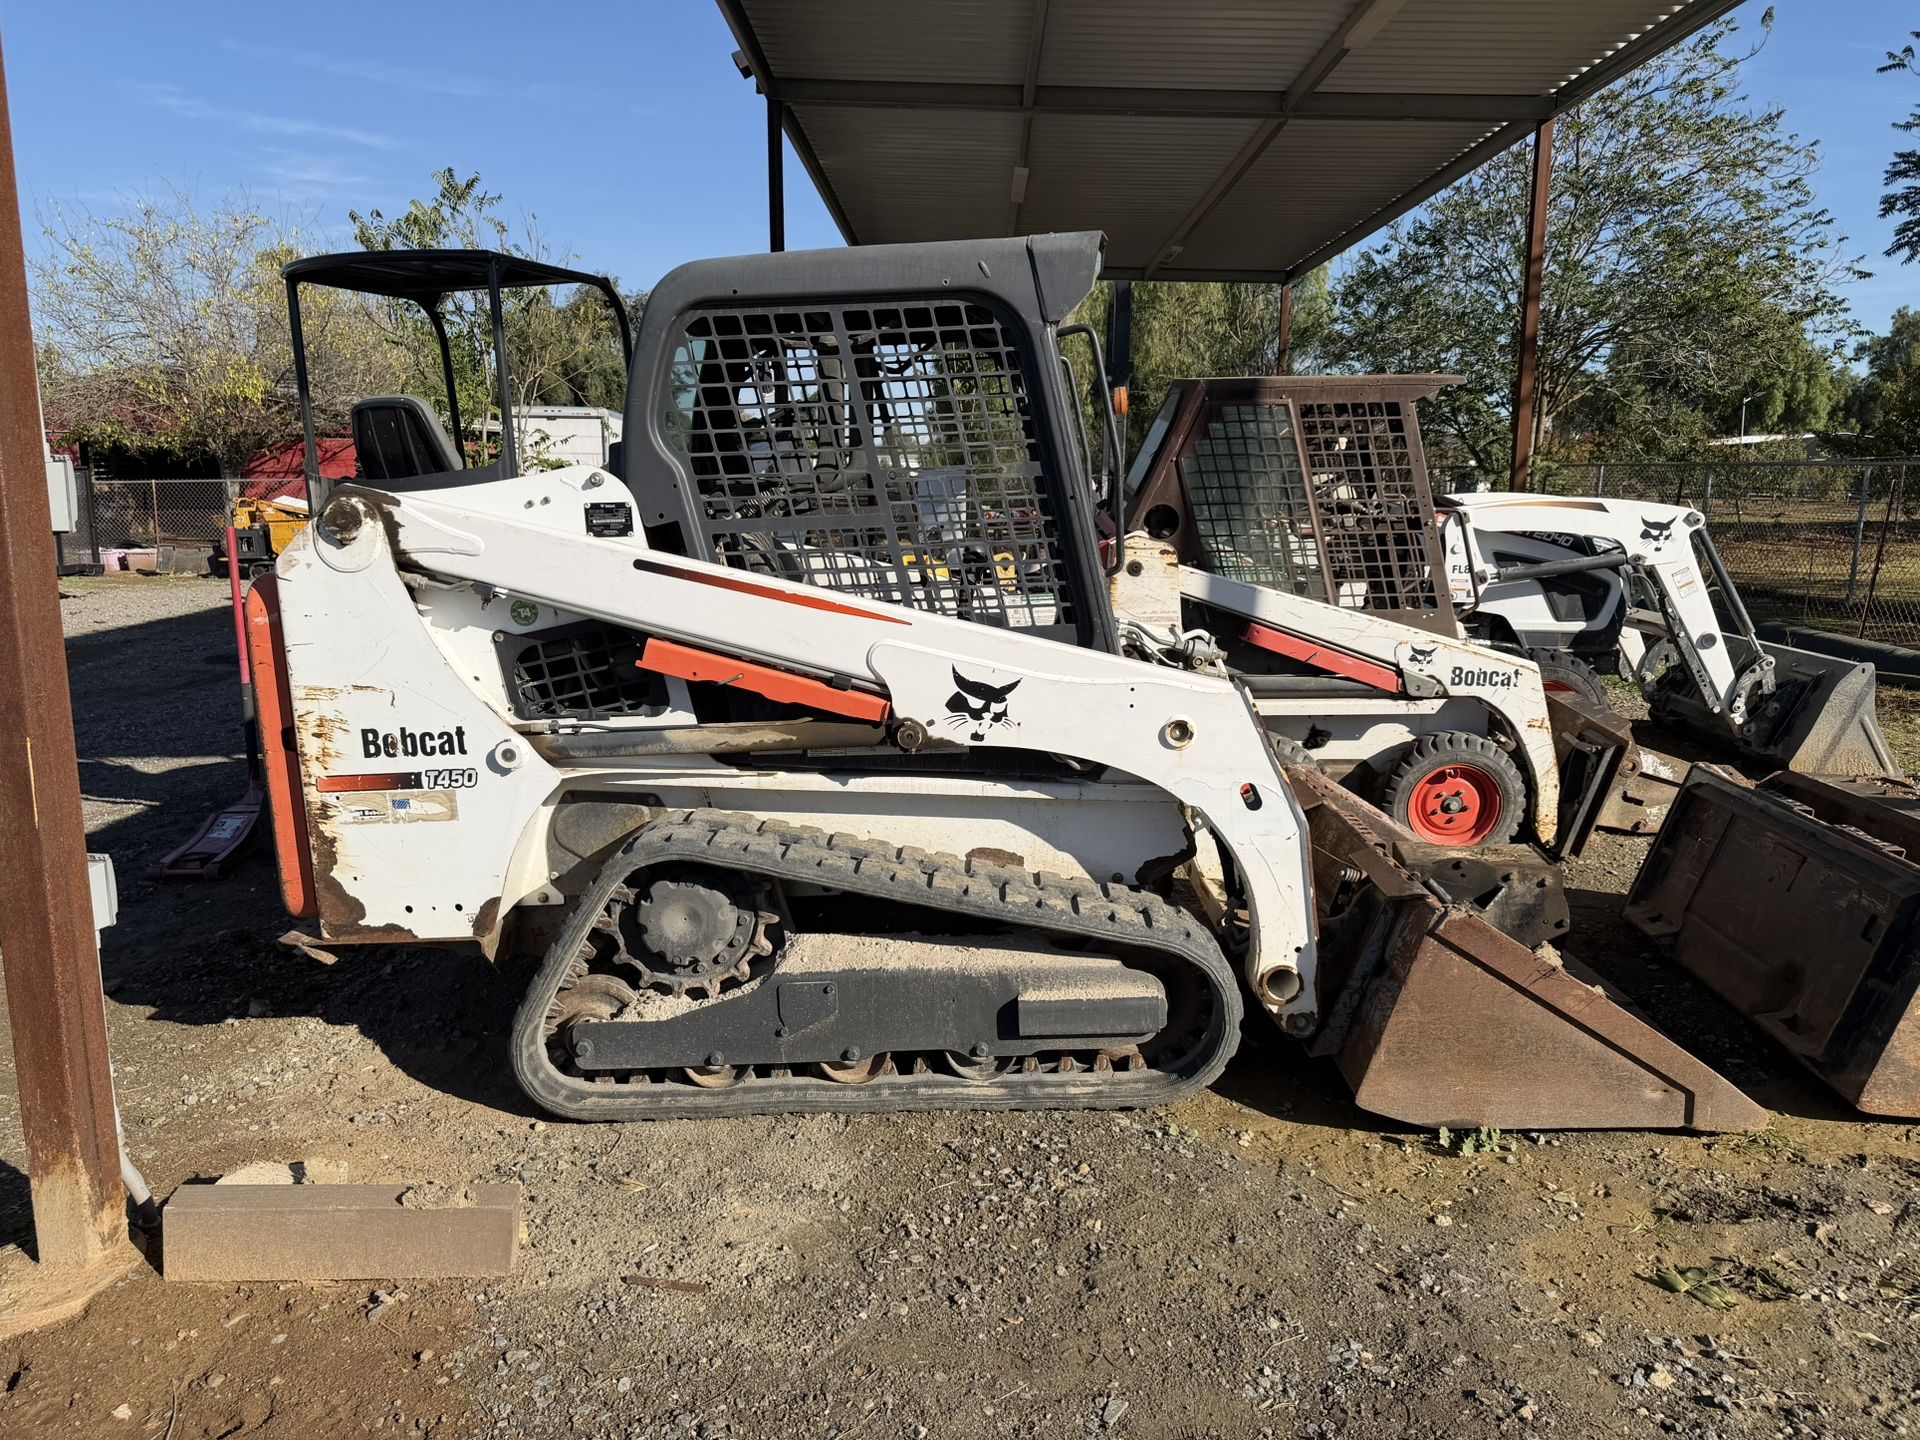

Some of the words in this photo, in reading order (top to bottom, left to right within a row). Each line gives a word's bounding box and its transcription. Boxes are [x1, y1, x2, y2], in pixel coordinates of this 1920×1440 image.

[1450, 666, 1523, 688] Bobcat
[361, 726, 468, 759] Bobcat
[425, 768, 478, 790] T450
